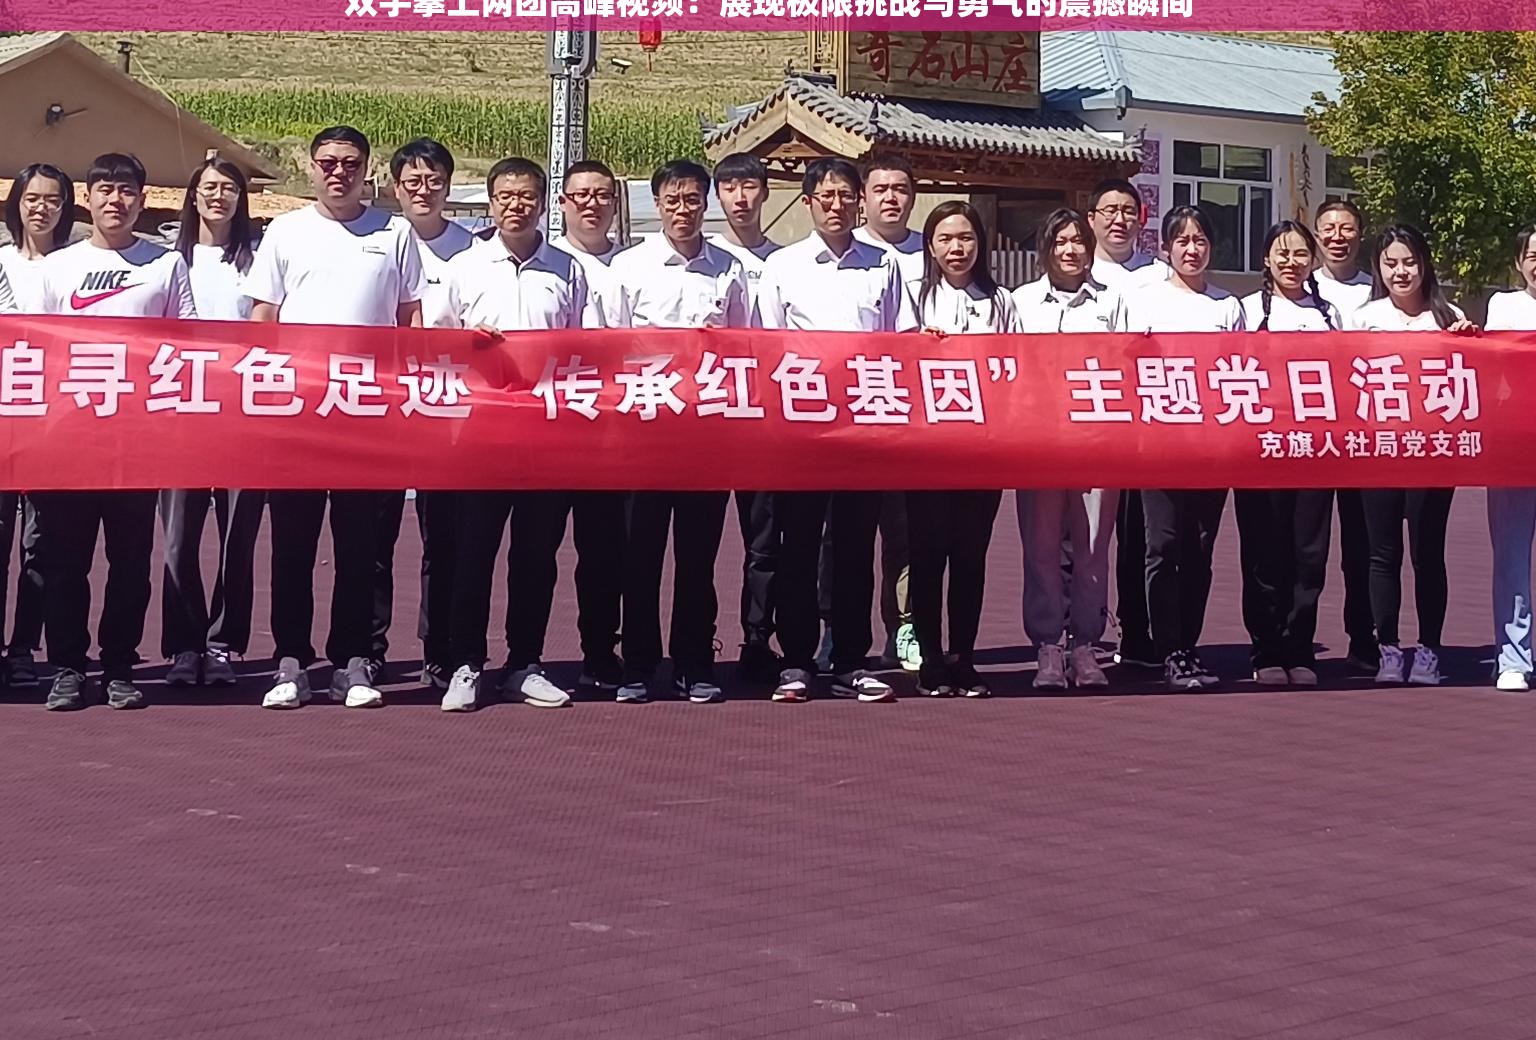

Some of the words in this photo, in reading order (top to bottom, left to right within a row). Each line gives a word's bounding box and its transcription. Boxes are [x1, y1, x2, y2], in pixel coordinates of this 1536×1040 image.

[79, 270, 132, 291] NIKE
[531, 351, 1018, 425] 传承红色基因”
[1065, 353, 1480, 424] 主题党日活动
[1257, 430, 1482, 459] 克旗人社局党支部
